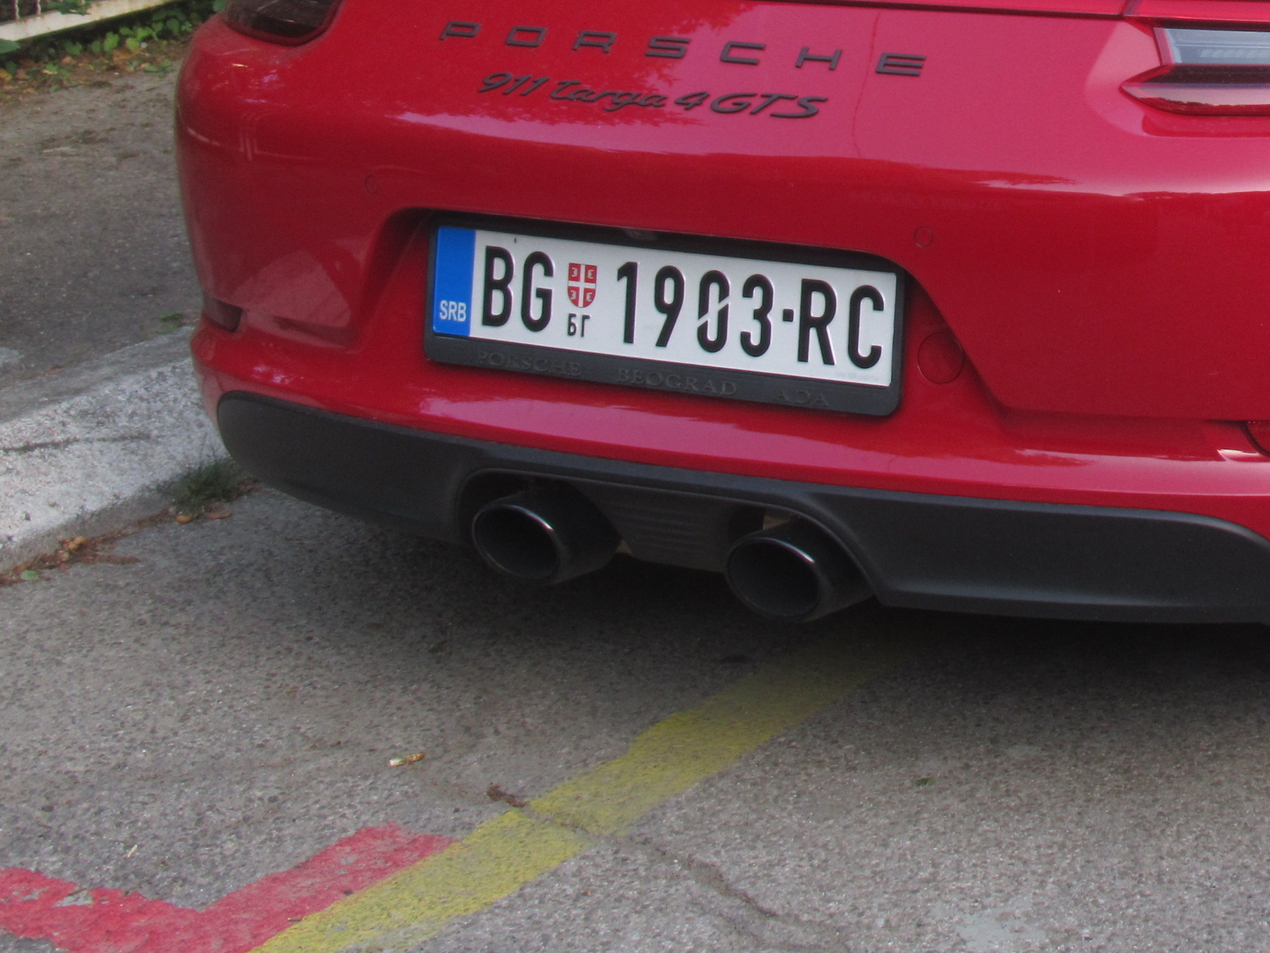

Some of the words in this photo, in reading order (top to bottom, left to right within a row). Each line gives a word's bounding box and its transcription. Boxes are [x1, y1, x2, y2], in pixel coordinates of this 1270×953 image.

[440, 20, 927, 77] PORSCHE
[478, 71, 551, 98] 911
[481, 245, 556, 333] BG
[438, 298, 468, 323] SRB
[616, 367, 738, 396] BEOGRAD
